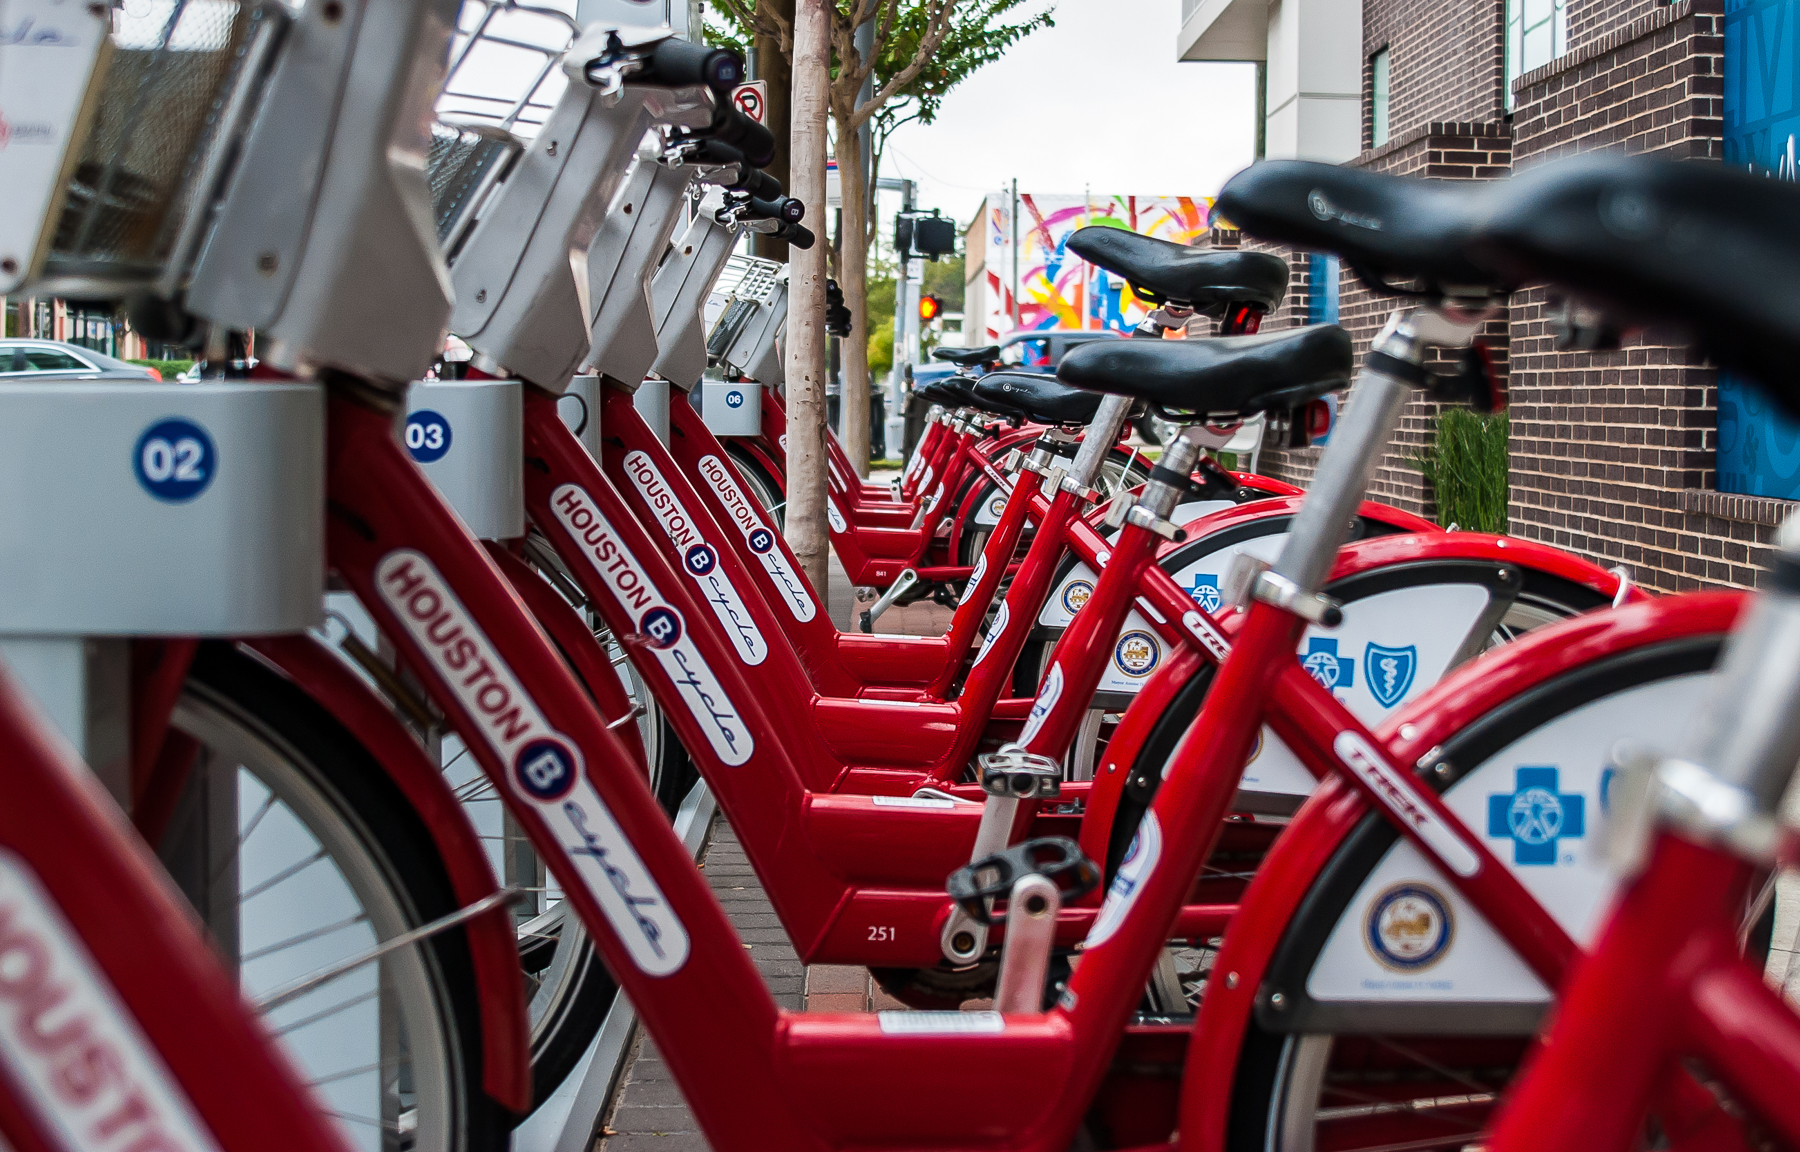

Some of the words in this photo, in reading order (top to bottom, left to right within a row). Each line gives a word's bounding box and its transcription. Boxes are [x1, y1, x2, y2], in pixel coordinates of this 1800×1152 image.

[727, 394, 742, 405] 06
[142, 436, 206, 482] 02
[405, 421, 445, 450] 03
[627, 454, 696, 547] HOUSTON
[708, 575, 756, 658] cycle
[701, 458, 757, 531] HOUSTON
[767, 553, 807, 616] cycle
[555, 488, 653, 611] HOUSTON
[671, 648, 739, 756] cycle
[1191, 616, 1229, 659] TRE
[384, 559, 533, 745] HOUSTON
[562, 799, 669, 961] cycle
[1350, 747, 1430, 828] TREK
[867, 925, 896, 942] 251
